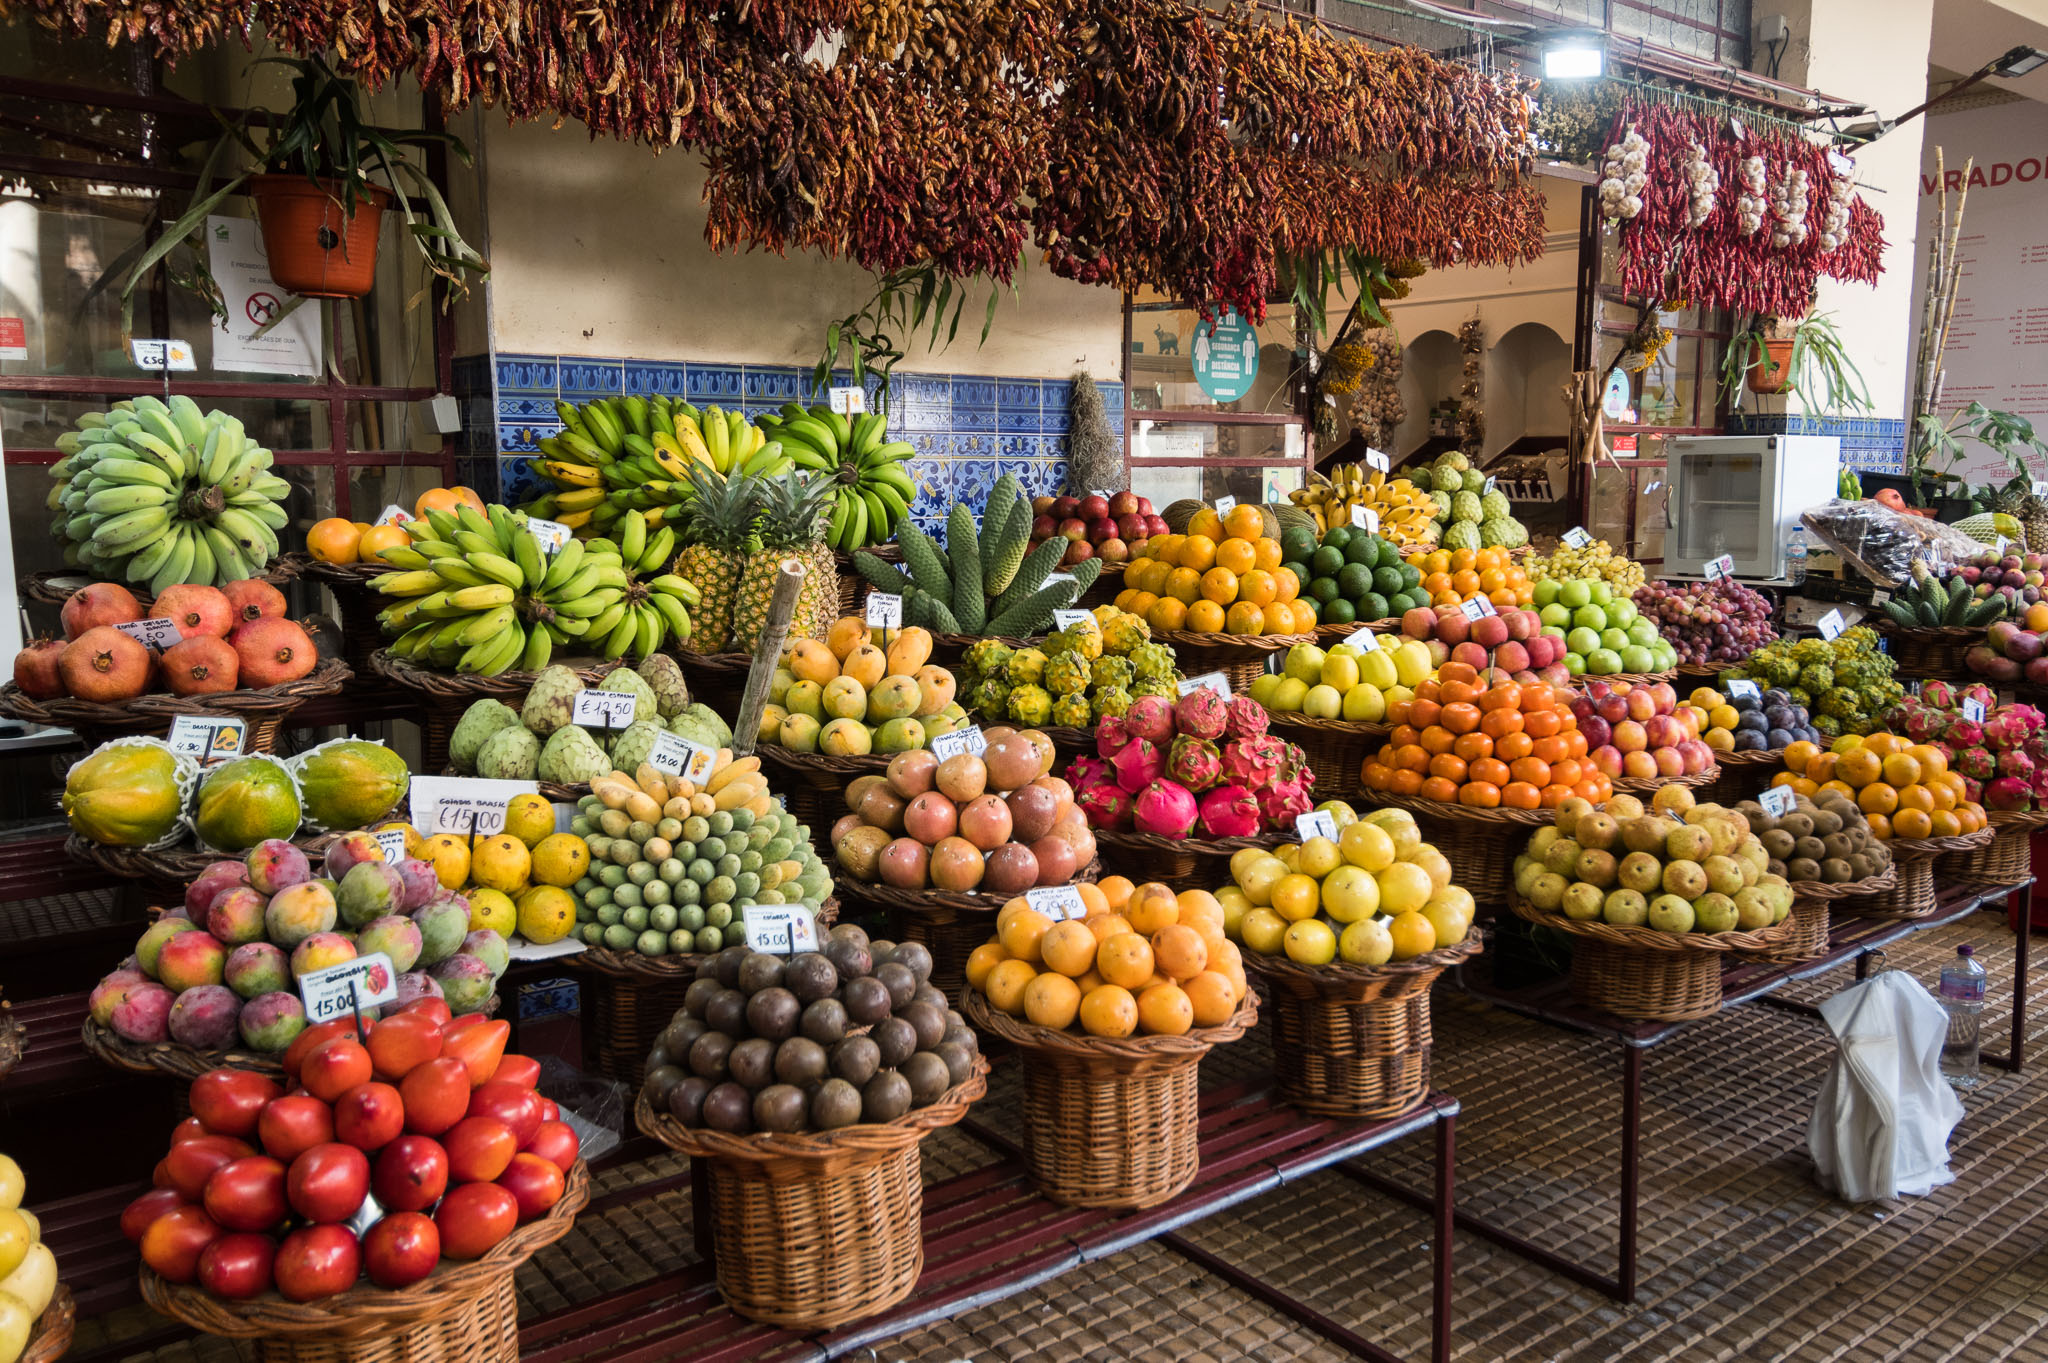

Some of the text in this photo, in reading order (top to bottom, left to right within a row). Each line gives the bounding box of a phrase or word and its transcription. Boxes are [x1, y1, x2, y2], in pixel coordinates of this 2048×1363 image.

[1919, 156, 2048, 197] VRADO
[439, 806, 502, 830] €1500
[314, 994, 356, 1017] 15.00
